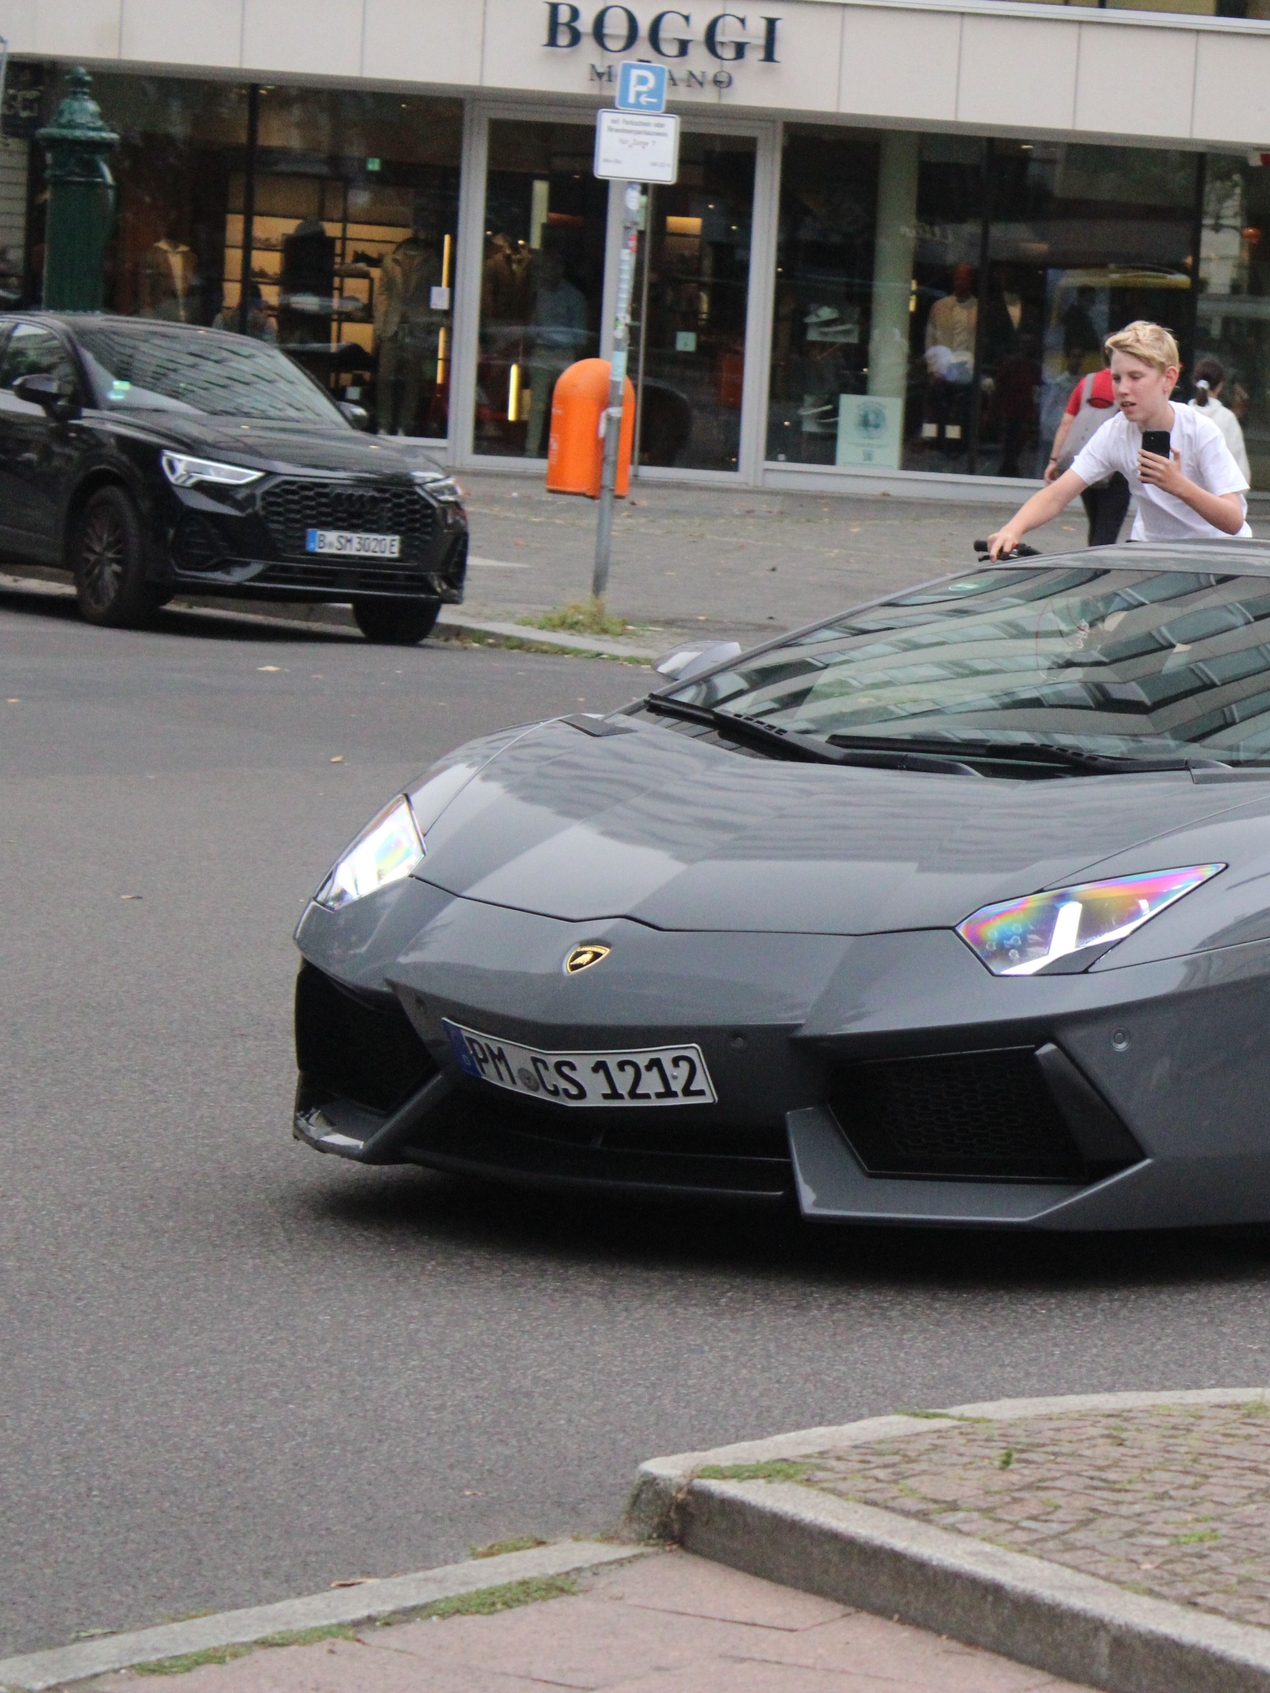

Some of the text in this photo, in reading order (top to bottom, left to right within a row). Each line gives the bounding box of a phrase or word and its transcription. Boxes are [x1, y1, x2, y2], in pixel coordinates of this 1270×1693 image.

[542, 2, 783, 63] BOGGI
[588, 62, 734, 89] MANO
[318, 533, 326, 549] B
[465, 1036, 517, 1086] PM
[531, 1056, 588, 1101] CS
[591, 1054, 706, 1101] 1212
